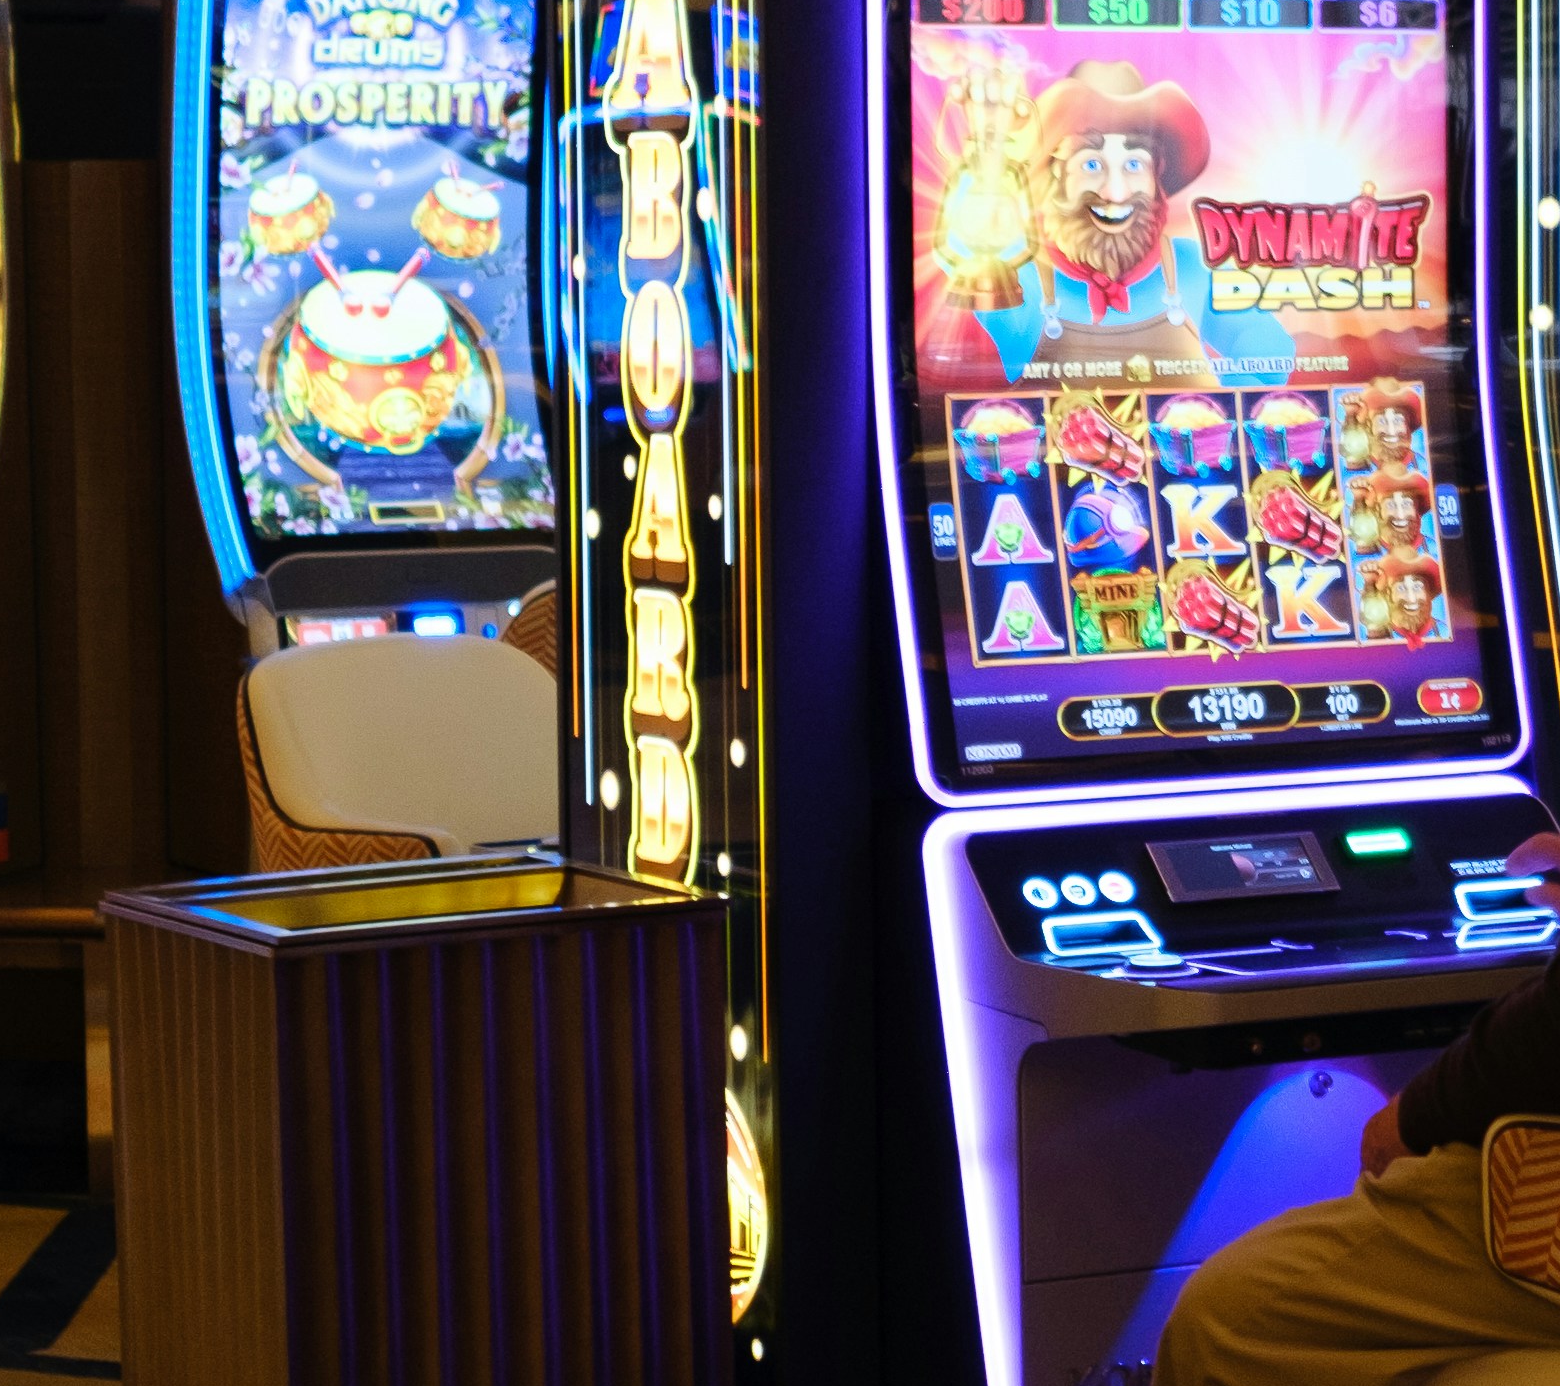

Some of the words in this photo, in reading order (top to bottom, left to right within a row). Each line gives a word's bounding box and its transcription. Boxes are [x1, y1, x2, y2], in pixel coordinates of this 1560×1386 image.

[1359, 0, 1397, 28] $6
[245, 78, 508, 127] PROSPERITY
[1196, 197, 1426, 268] DYNAMITE
[1211, 266, 1415, 311] DASH
[1085, 361, 1122, 377] MORE
[1295, 355, 1349, 372] FEATURE
[1161, 484, 1248, 557] K
[1438, 495, 1458, 516] 50
[933, 514, 954, 536] 50
[972, 494, 1054, 566] A
[1095, 583, 1139, 602] MINE
[1266, 565, 1349, 638] K
[982, 580, 1064, 654] A
[1188, 692, 1265, 724] 13190
[1326, 694, 1359, 715] 100
[1439, 692, 1460, 711] 1¢
[1081, 706, 1139, 731] 15090
